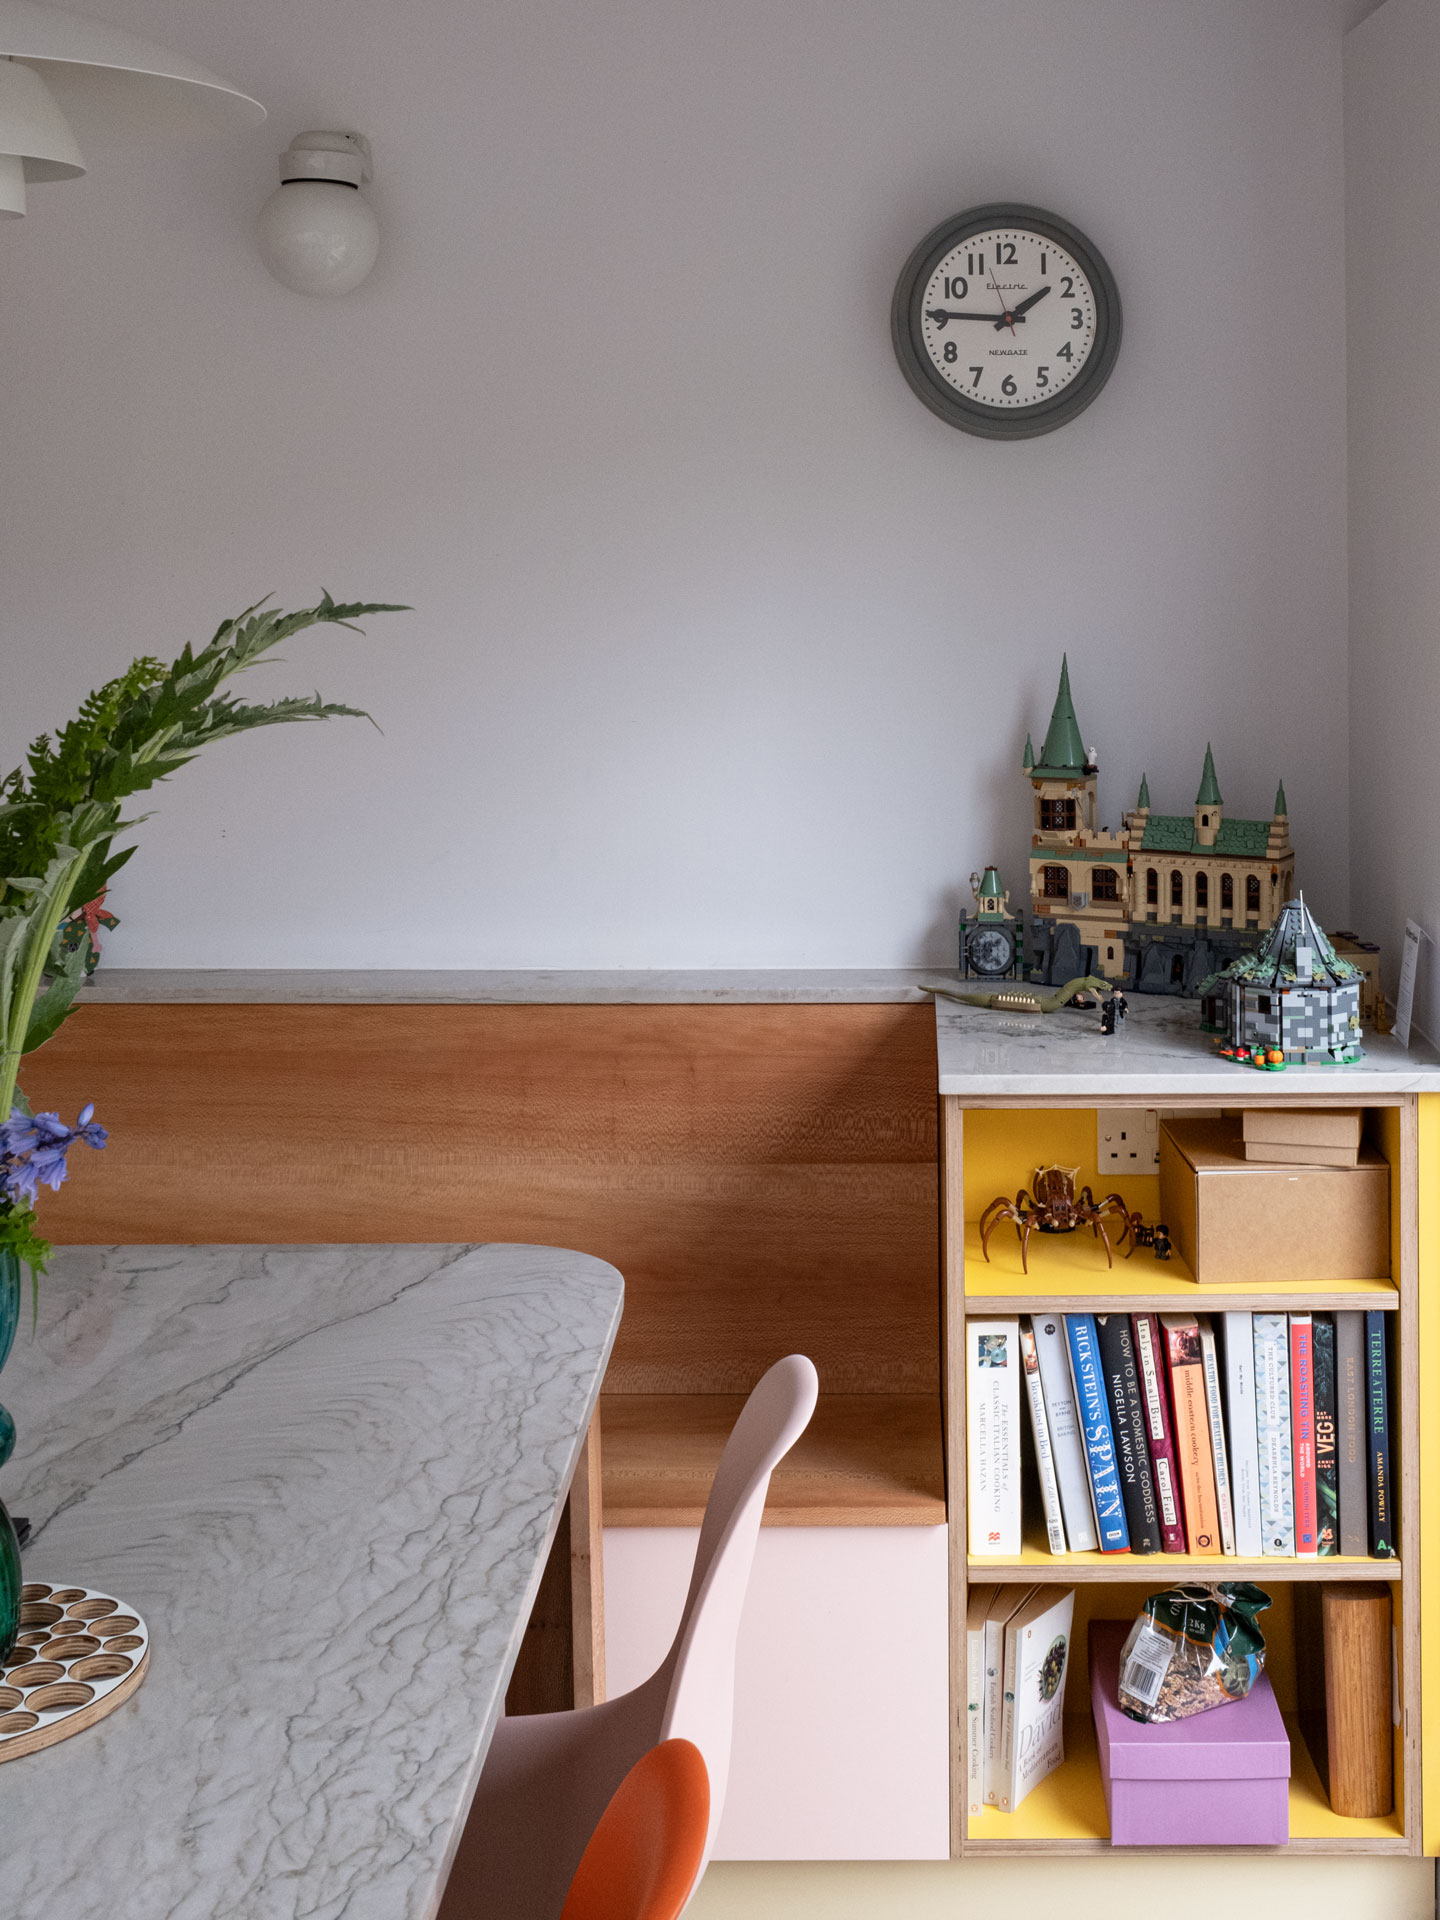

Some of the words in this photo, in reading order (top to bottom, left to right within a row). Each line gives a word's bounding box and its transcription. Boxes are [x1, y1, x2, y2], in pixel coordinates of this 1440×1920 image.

[968, 253, 984, 275] 11
[996, 243, 1018, 264] 12
[1041, 253, 1046, 275] 1
[945, 277, 968, 299] 10
[1060, 277, 1075, 298] 2
[1071, 308, 1084, 329] 3
[943, 341, 958, 363] 8
[1056, 341, 1073, 362] 4
[969, 367, 984, 388] 7
[1001, 374, 1017, 396] 6
[1036, 367, 1049, 388] 5
[1075, 1326, 1091, 1362] RICK
[1120, 1330, 1131, 1358] HOW
[1299, 1334, 1307, 1355] THE
[1371, 1330, 1382, 1377] TERRE
[1124, 1362, 1134, 1377] TO
[1144, 1355, 1150, 1366] in
[1206, 1354, 1216, 1383] HEALTHY
[1081, 1363, 1101, 1421] STEIN'S
[1127, 1381, 1137, 1394] BE
[1146, 1370, 1157, 1404] Small
[1185, 1370, 1194, 1398] middle
[1209, 1385, 1218, 1404] FOOD
[1300, 1359, 1308, 1417] ROASTING
[1130, 1399, 1138, 1407] A
[1187, 1401, 1195, 1432] eastern
[1211, 1406, 1219, 1419] FOR
[1347, 1388, 1355, 1431] LONDON
[1373, 1387, 1384, 1434] TERRE
[1031, 1380, 1043, 1426] Breakfast
[1040, 1440, 1050, 1459] Bed
[1112, 1375, 1127, 1425] NIGELLA
[1120, 1431, 1136, 1483] LAWSON
[1151, 1407, 1159, 1437] Bites
[1300, 1421, 1309, 1439] TIN
[1131, 1411, 1147, 1466] DOMESTIC
[1191, 1433, 1199, 1466] cookery
[1213, 1421, 1222, 1450] HEALTHY
[1316, 1422, 1334, 1453] VEG
[1348, 1434, 1356, 1463] FOOD
[1086, 1425, 1122, 1517] SPAIN
[1158, 1461, 1170, 1491] Carol
[1215, 1452, 1225, 1487] CHILDREN
[1140, 1471, 1155, 1524] GODDESS
[1163, 1495, 1175, 1523] Field
[1378, 1489, 1386, 1523] POWLEY
[1190, 1618, 1205, 1631] 2Kg
[1019, 1691, 1062, 1759] David
